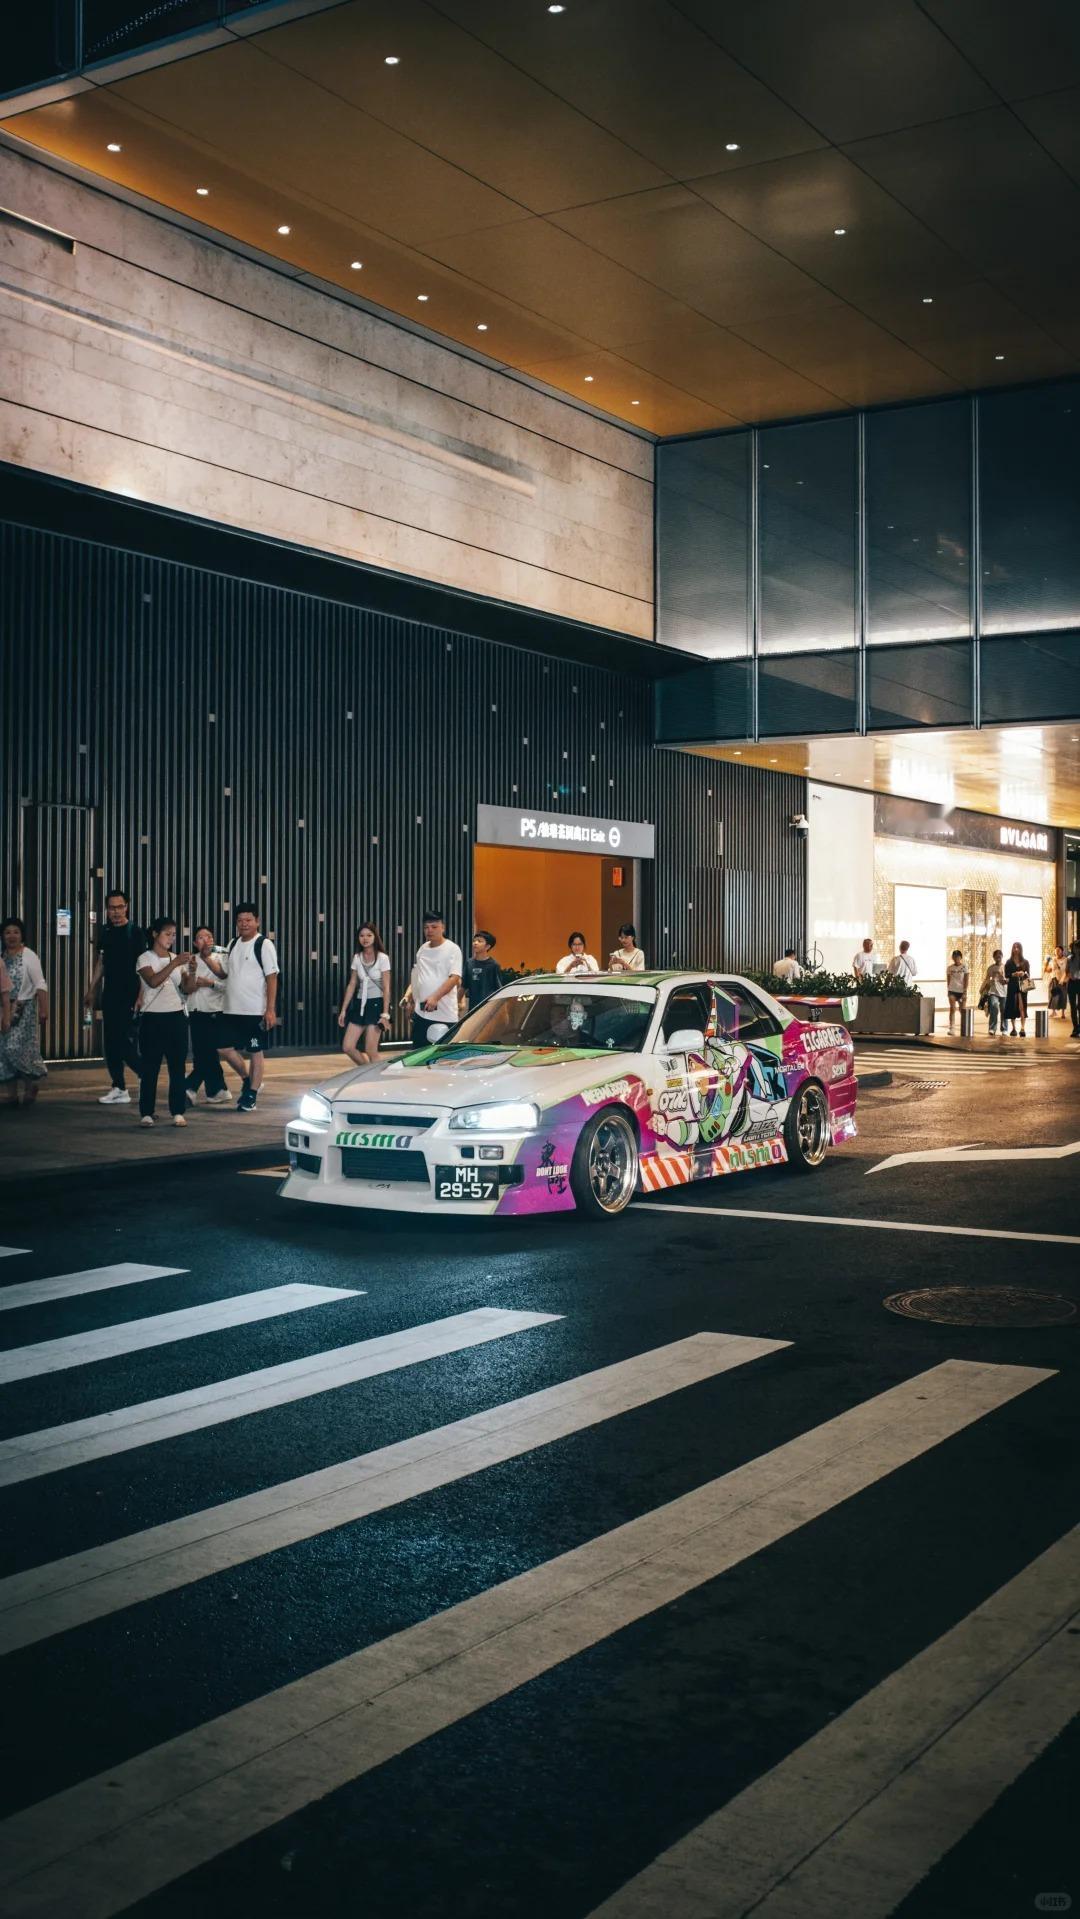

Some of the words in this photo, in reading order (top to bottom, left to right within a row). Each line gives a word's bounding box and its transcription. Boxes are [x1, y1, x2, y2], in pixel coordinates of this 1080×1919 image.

[520, 817, 537, 838] P5
[999, 826, 1048, 852] BVLGARI
[336, 1131, 414, 1149] nismo
[455, 1167, 479, 1183] MH
[439, 1182, 495, 1199] 29-57
